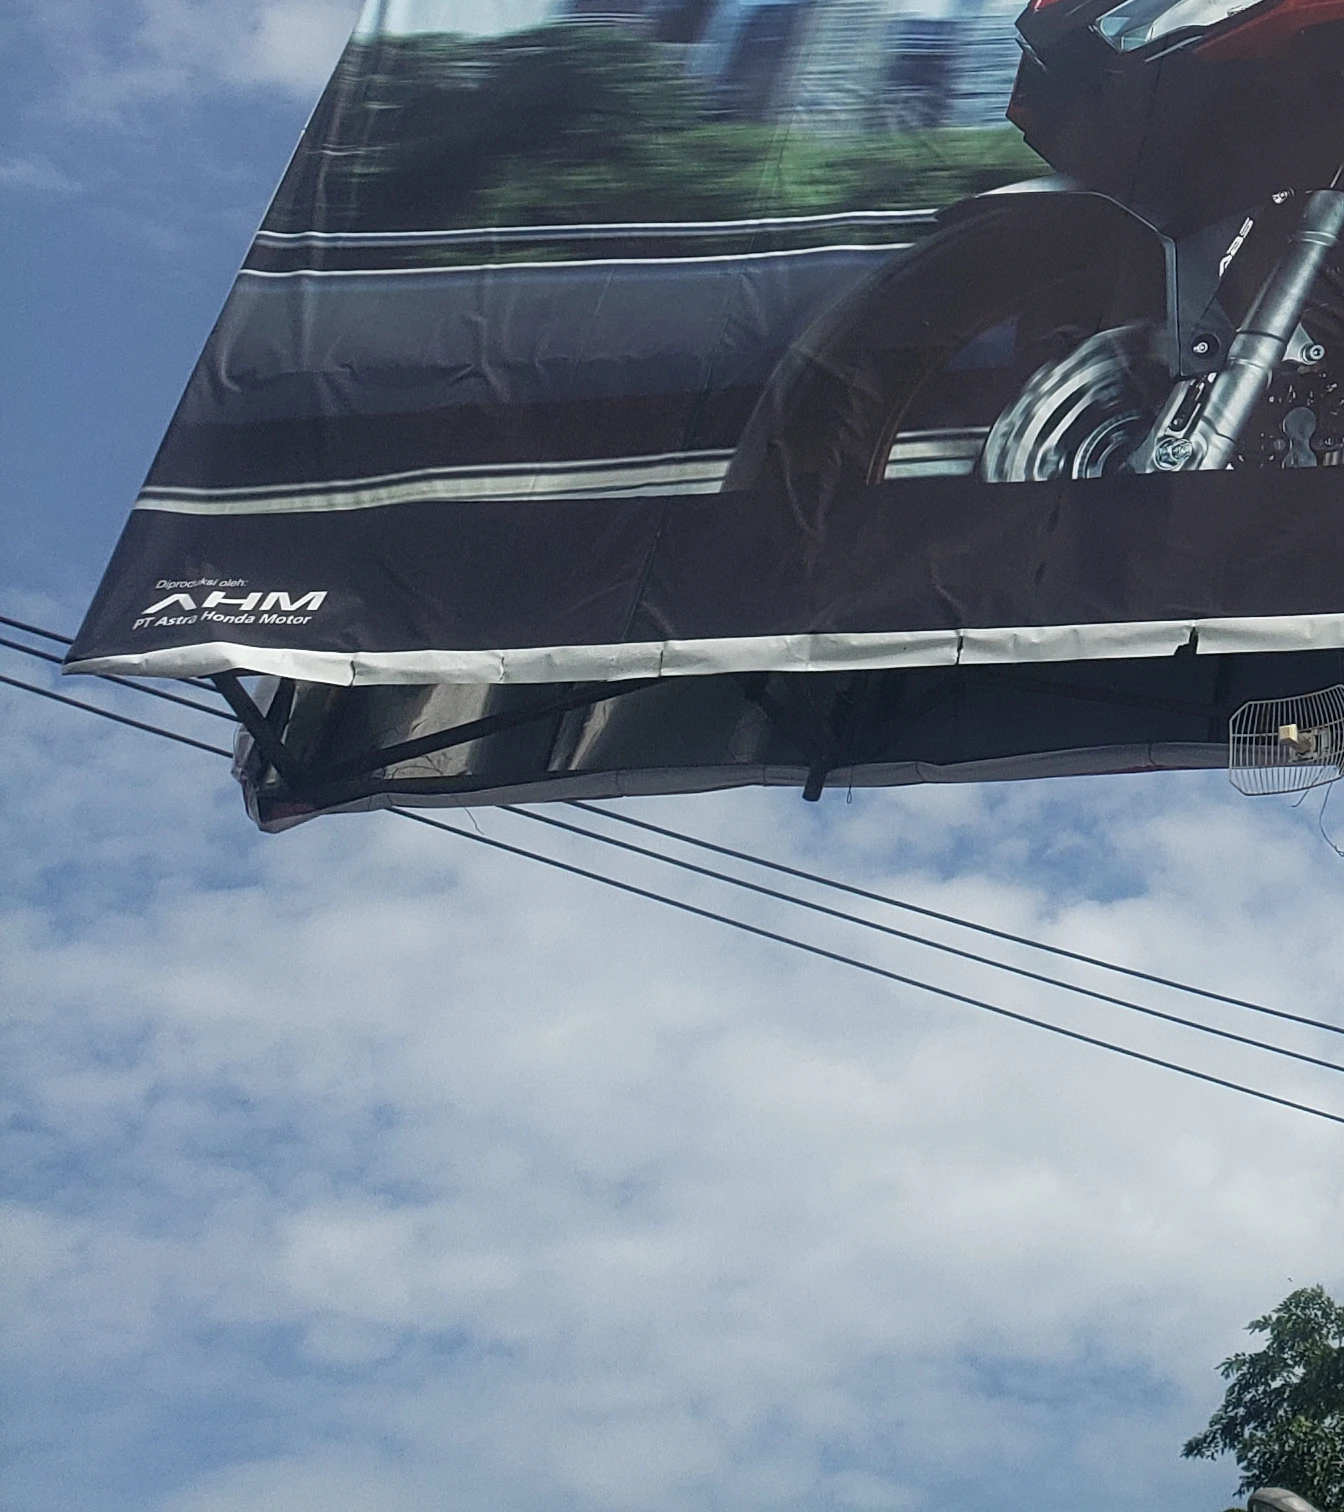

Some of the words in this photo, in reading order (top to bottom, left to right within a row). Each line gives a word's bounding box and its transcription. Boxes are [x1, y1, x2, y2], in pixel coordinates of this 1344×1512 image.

[218, 578, 249, 588] oleh:
[141, 591, 328, 615] AHM
[132, 617, 153, 630] PT
[154, 614, 198, 627] Astra
[201, 610, 255, 624] Honda
[258, 613, 312, 625] Motor
